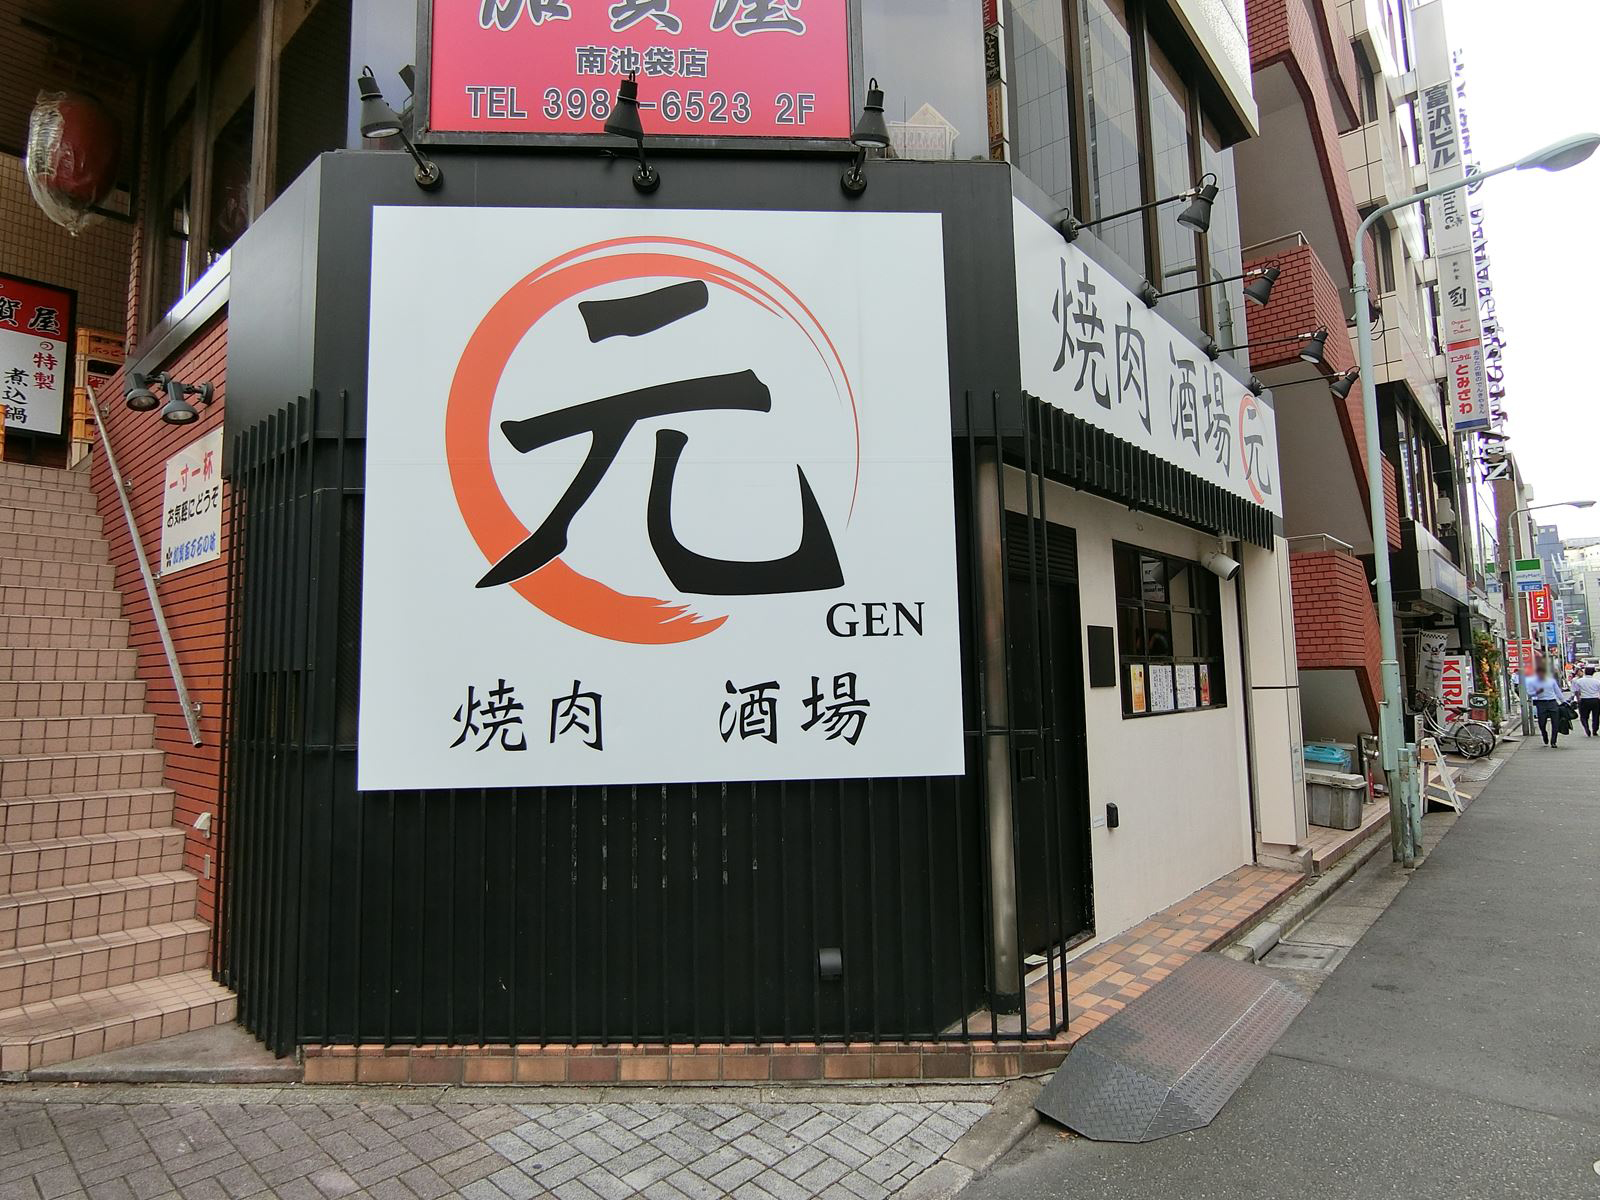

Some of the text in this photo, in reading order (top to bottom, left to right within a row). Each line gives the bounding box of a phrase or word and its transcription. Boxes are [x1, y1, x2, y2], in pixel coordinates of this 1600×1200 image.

[576, 45, 709, 78] 南池袋店
[466, 86, 815, 125] TEL 398-6523 2F
[1425, 84, 1456, 169] 富沢ビル
[33, 341, 58, 391] の特製
[1052, 257, 1272, 495] 焼肉 酒場 元
[475, 279, 846, 594] 元
[169, 450, 214, 492] 一寸一杯
[167, 485, 219, 528] お気軽にどうぞ
[826, 602, 925, 638] GEN
[1535, 596, 1546, 617] ガスト
[449, 671, 871, 753] 焼肉 酒場
